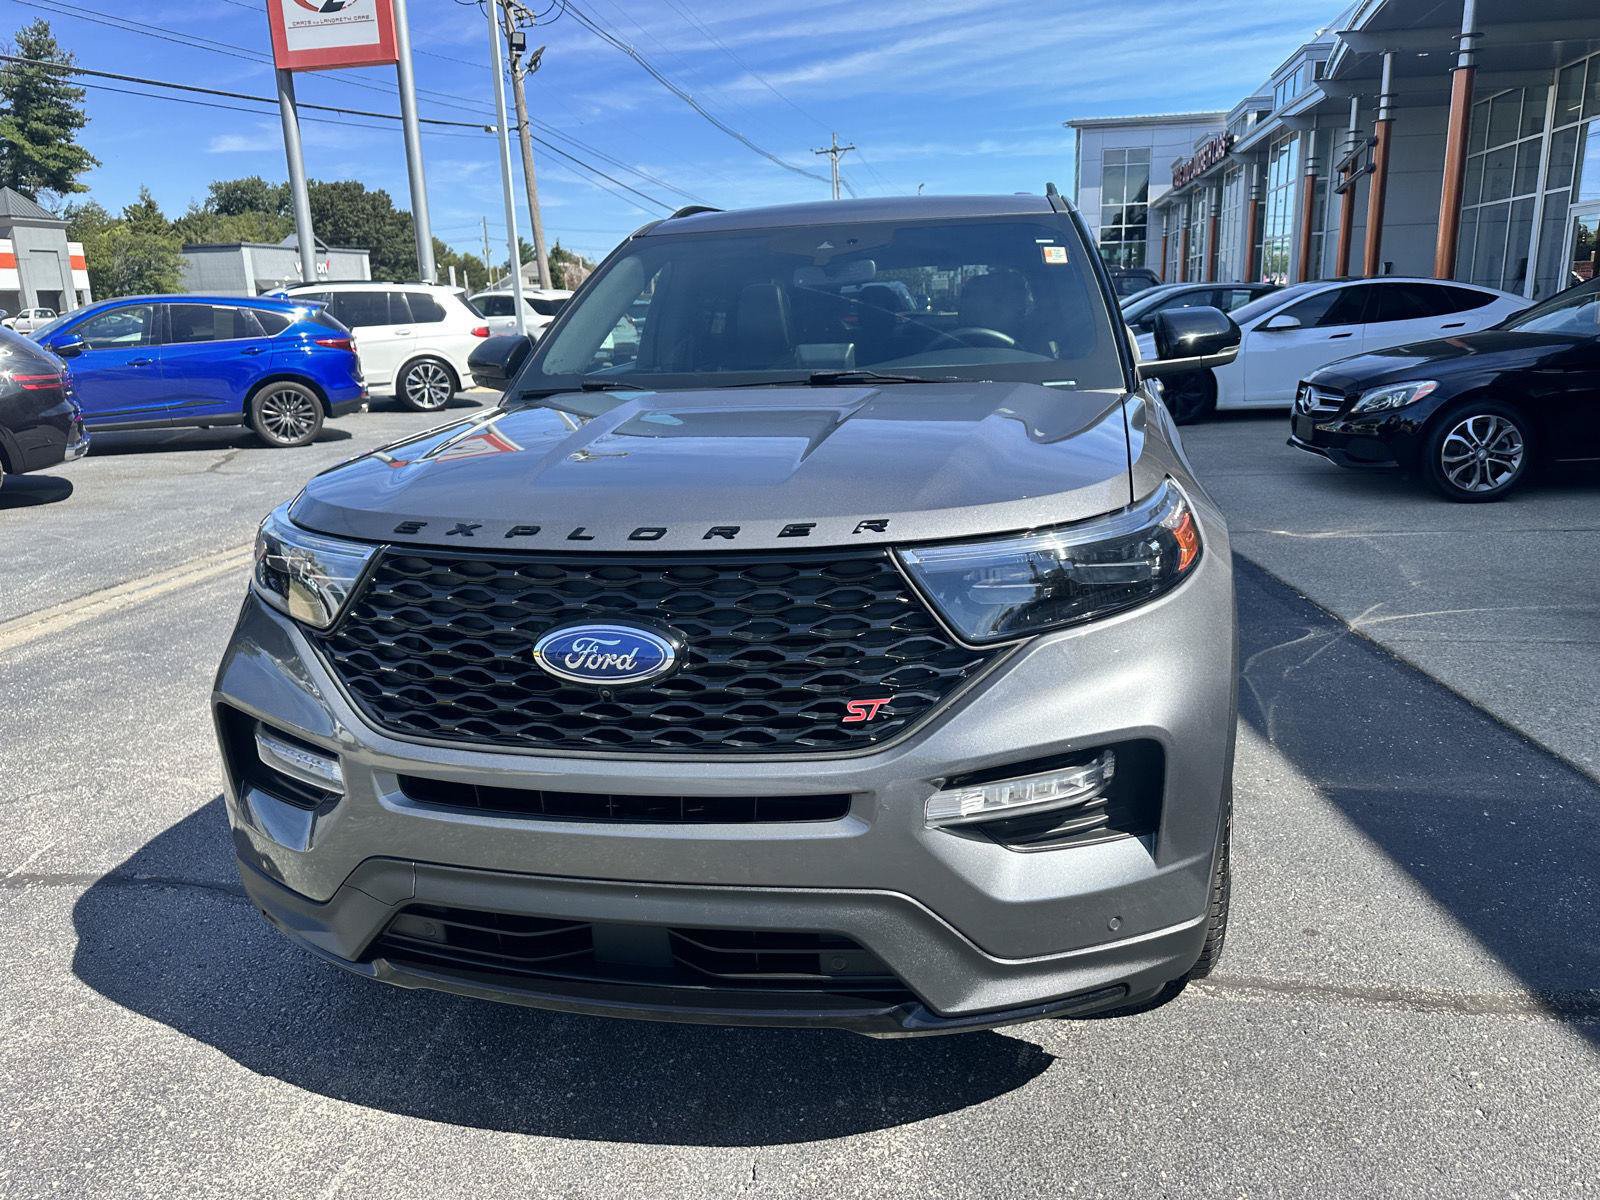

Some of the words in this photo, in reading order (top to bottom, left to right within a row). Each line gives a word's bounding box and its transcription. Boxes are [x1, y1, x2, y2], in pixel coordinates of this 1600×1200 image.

[393, 518, 890, 541] EXPLORER
[564, 637, 640, 670] Ford
[842, 698, 891, 722] ST
